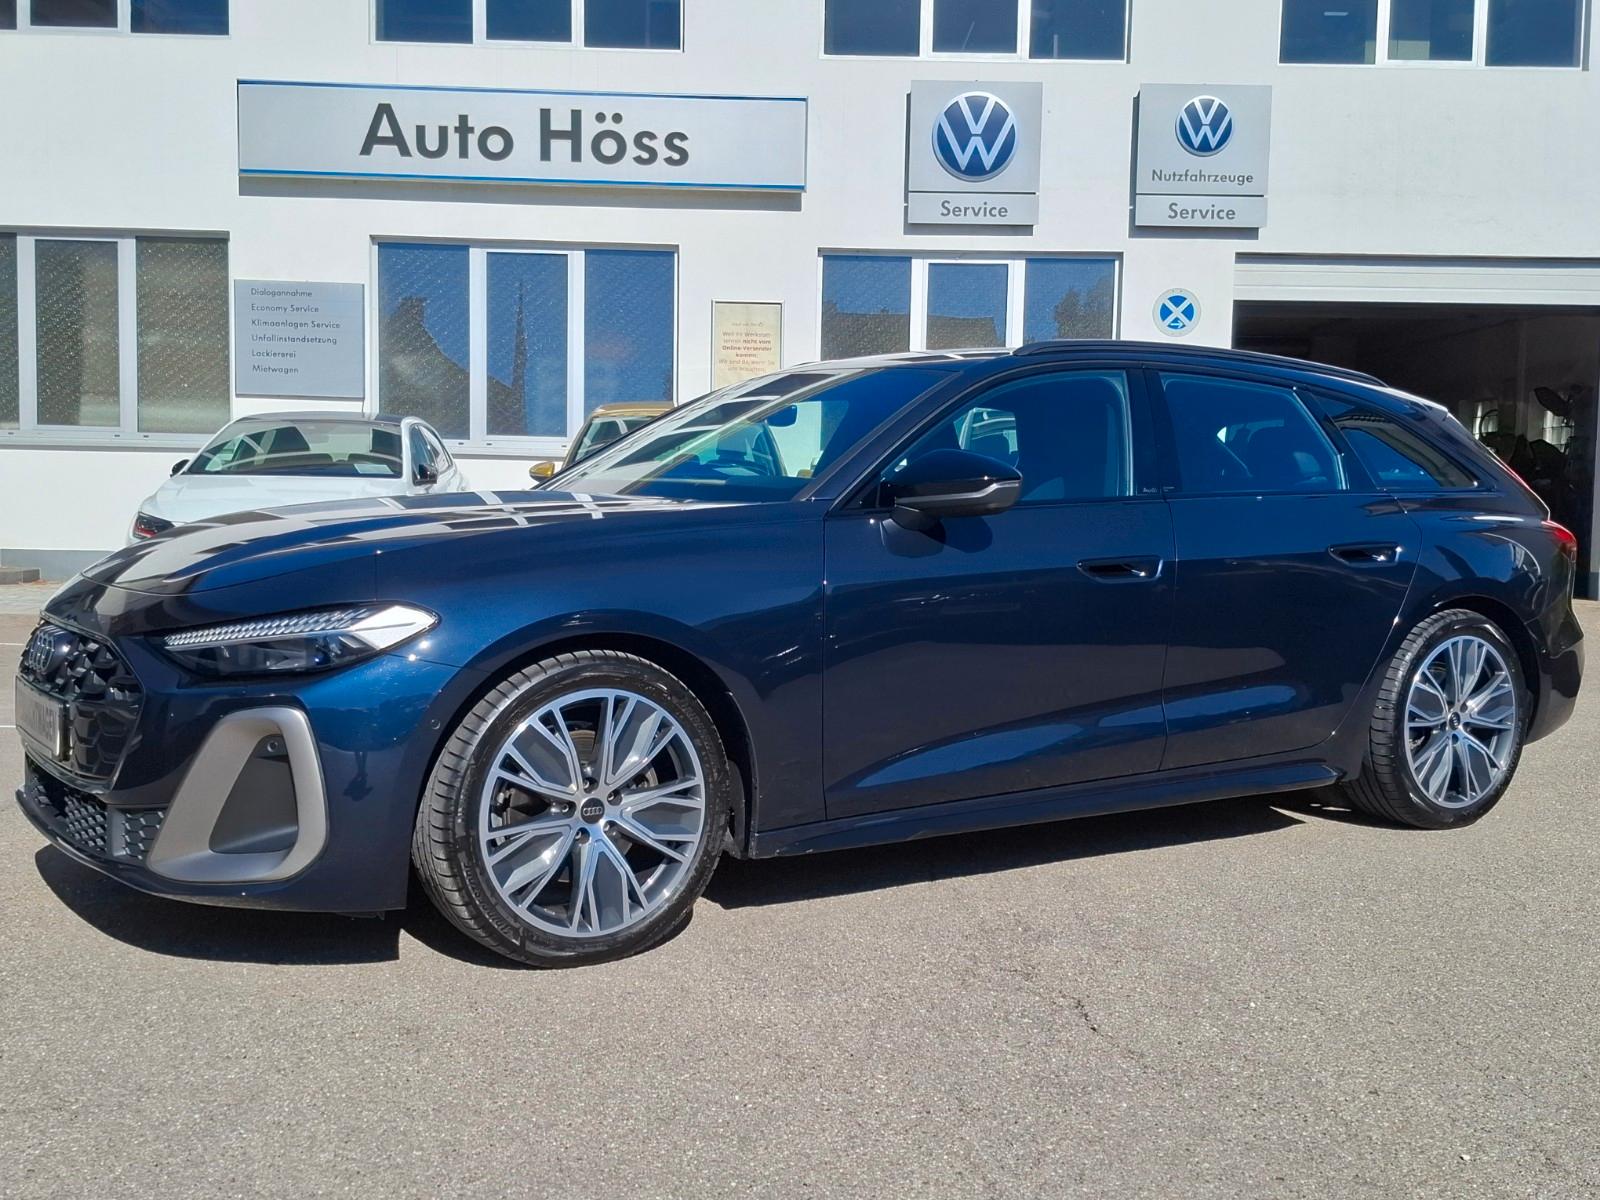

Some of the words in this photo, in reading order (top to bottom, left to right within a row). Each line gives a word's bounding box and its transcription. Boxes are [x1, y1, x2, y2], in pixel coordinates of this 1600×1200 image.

[359, 103, 514, 161] Auto
[540, 108, 689, 166] Höss
[1151, 169, 1254, 186] Nutzfahrzeuge
[940, 200, 1008, 218] Service
[1167, 203, 1236, 221] Service
[250, 287, 312, 298] Dialogannahme
[251, 303, 288, 313] Economy
[290, 304, 319, 313] Service
[251, 319, 309, 329] Klimaanlagen
[311, 320, 340, 329] Service
[251, 334, 337, 345] Unfallinstandsetzung
[251, 349, 297, 358] Lackiererei
[252, 364, 299, 374] Mietwagen
